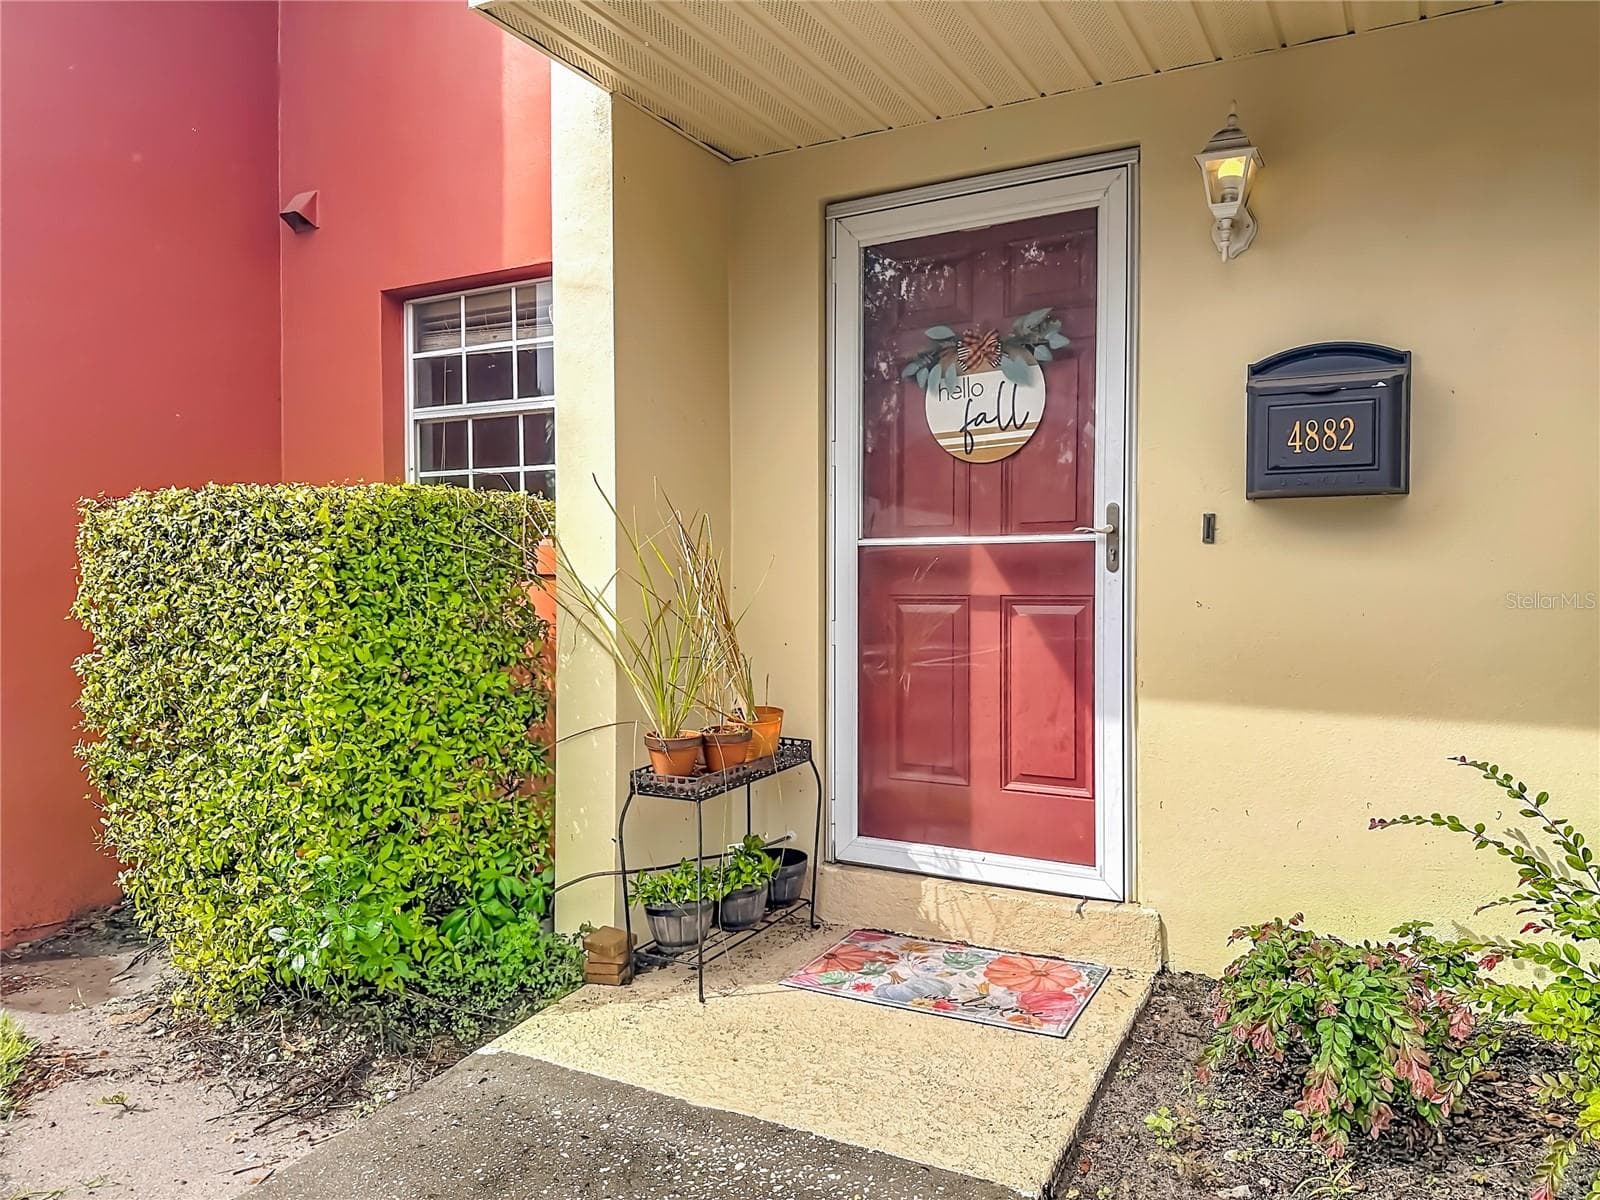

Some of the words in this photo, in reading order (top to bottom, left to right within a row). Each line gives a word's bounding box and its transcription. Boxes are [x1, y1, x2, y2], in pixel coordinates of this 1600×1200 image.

[938, 377, 985, 402] hello
[959, 380, 1030, 455] fall
[1287, 416, 1355, 453] 4882
